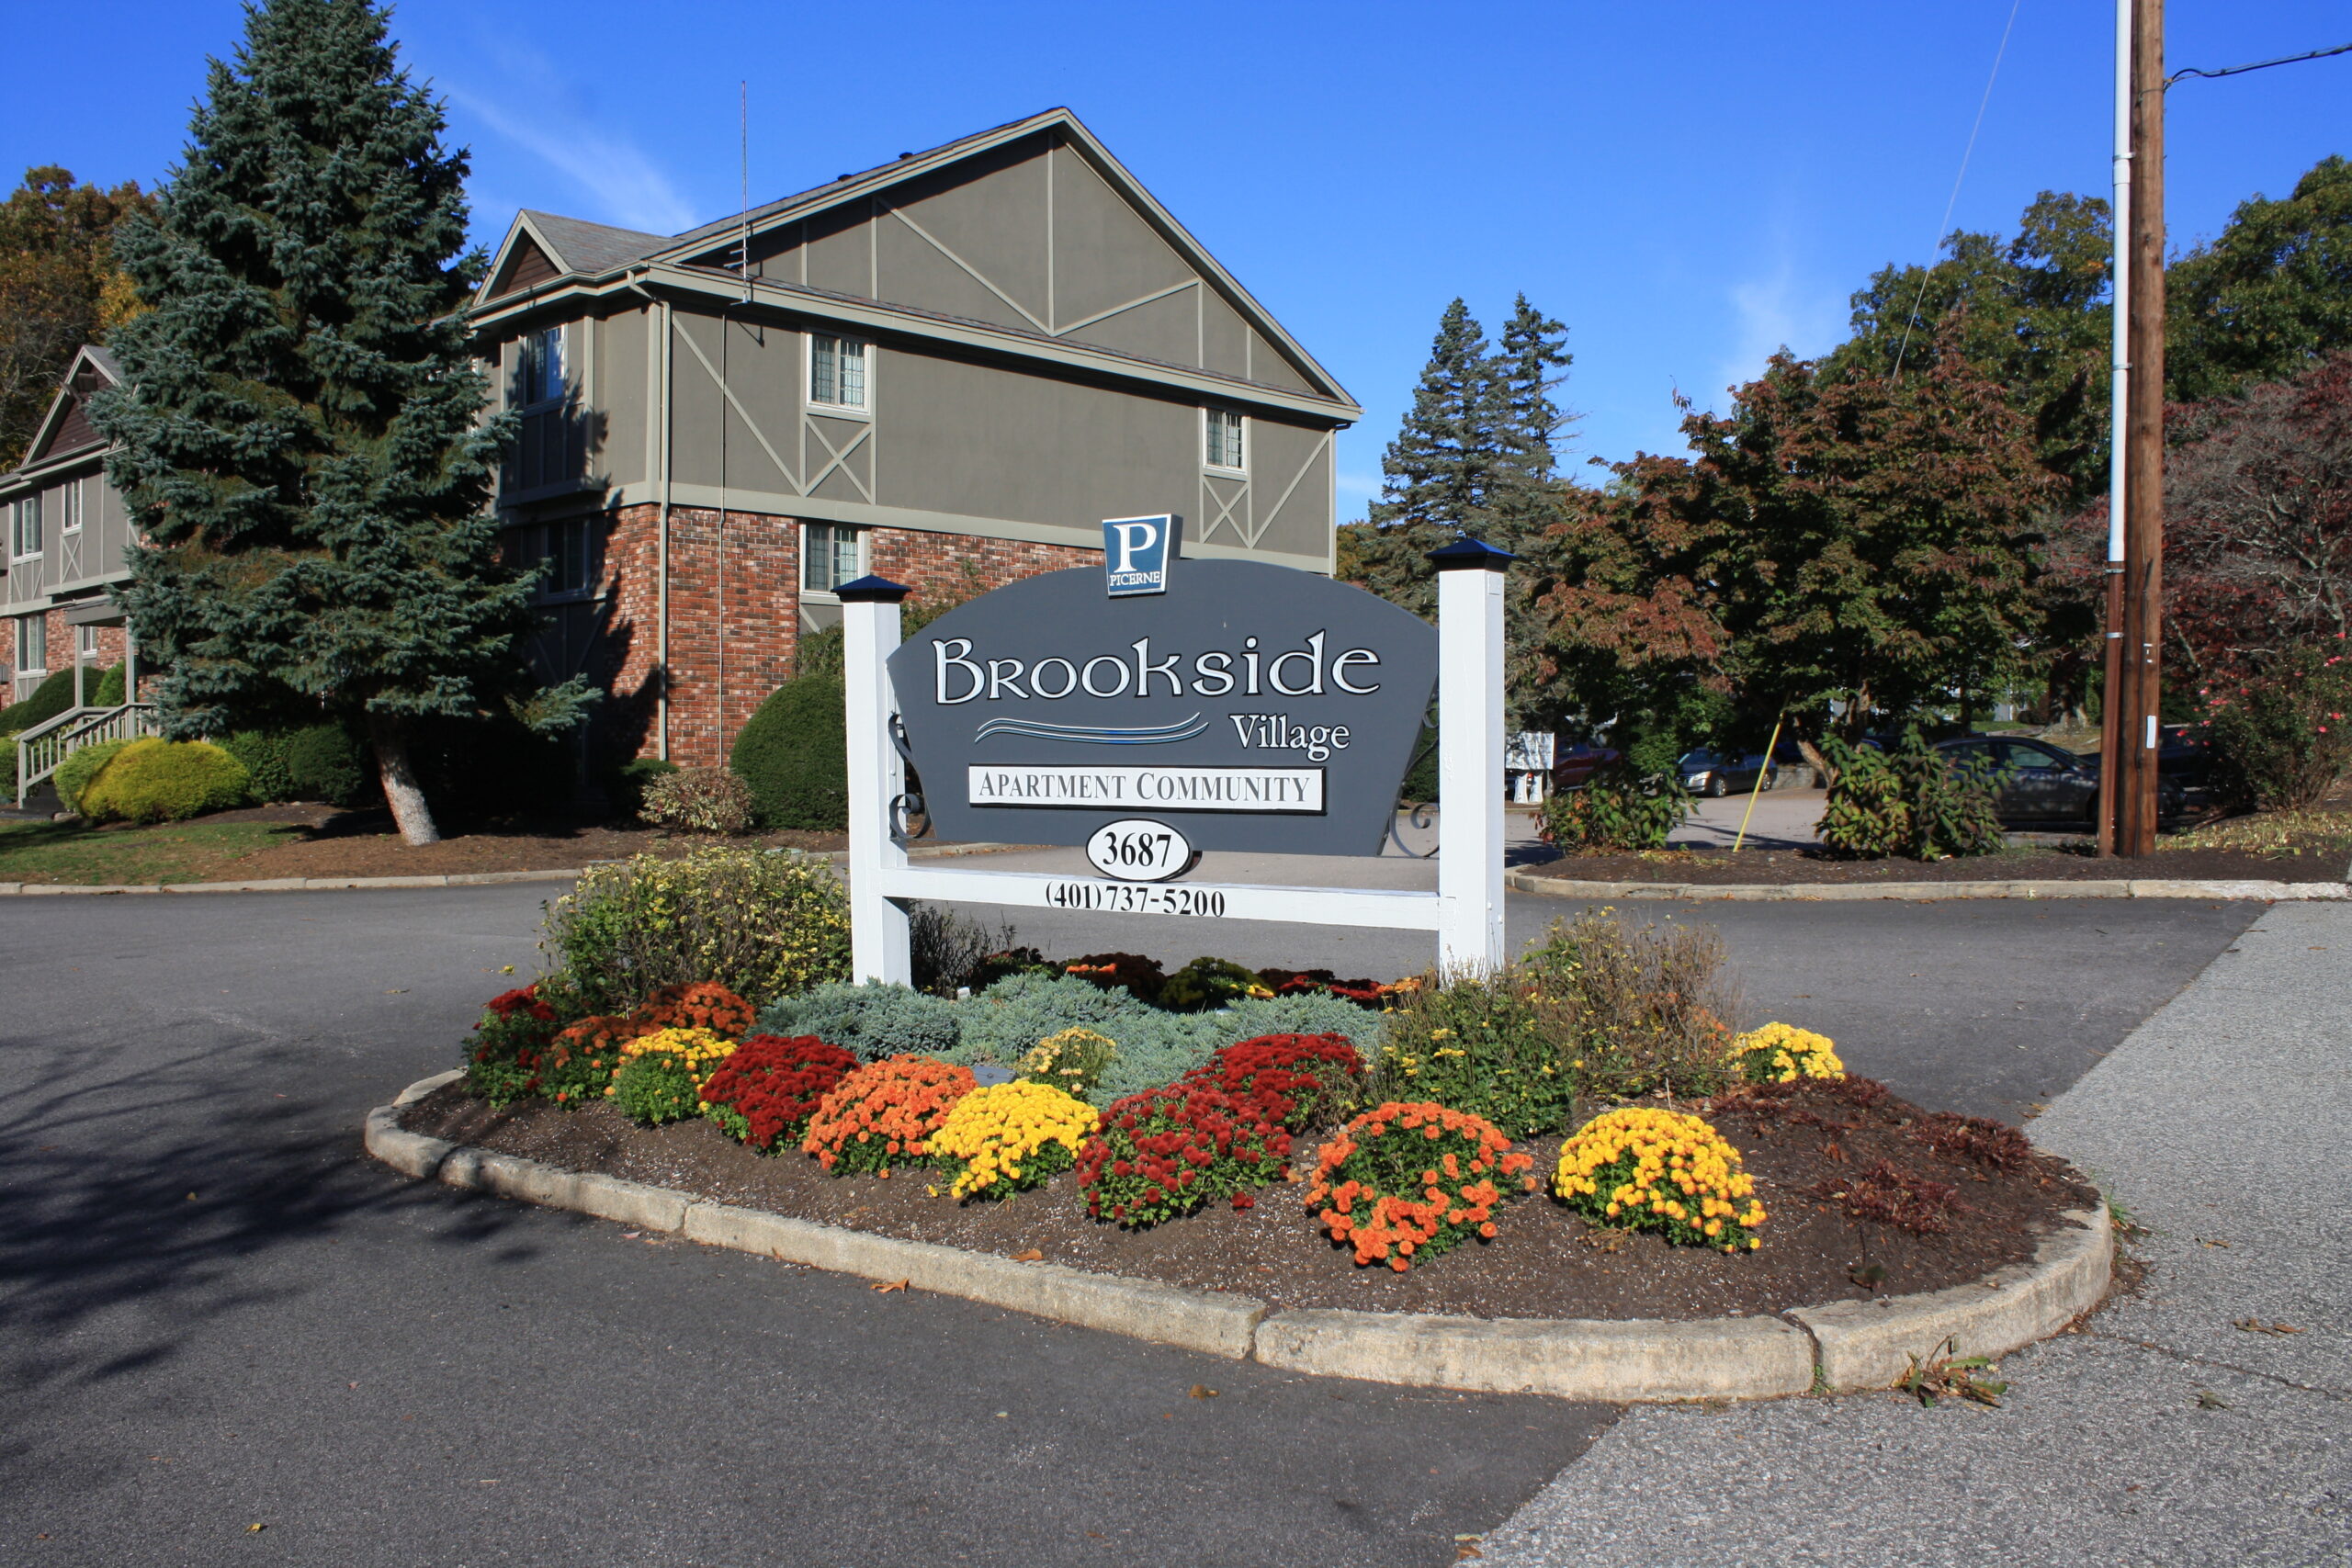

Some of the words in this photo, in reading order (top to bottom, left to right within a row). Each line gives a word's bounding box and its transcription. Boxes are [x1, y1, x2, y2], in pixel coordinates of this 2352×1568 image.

[1112, 523, 1157, 573] P
[1109, 571, 1161, 586] PICERNE
[1229, 713, 1351, 762] Village
[978, 771, 1126, 799] APARTMENT
[1136, 772, 1311, 803] COMMUNITY
[1102, 831, 1171, 867] 3687
